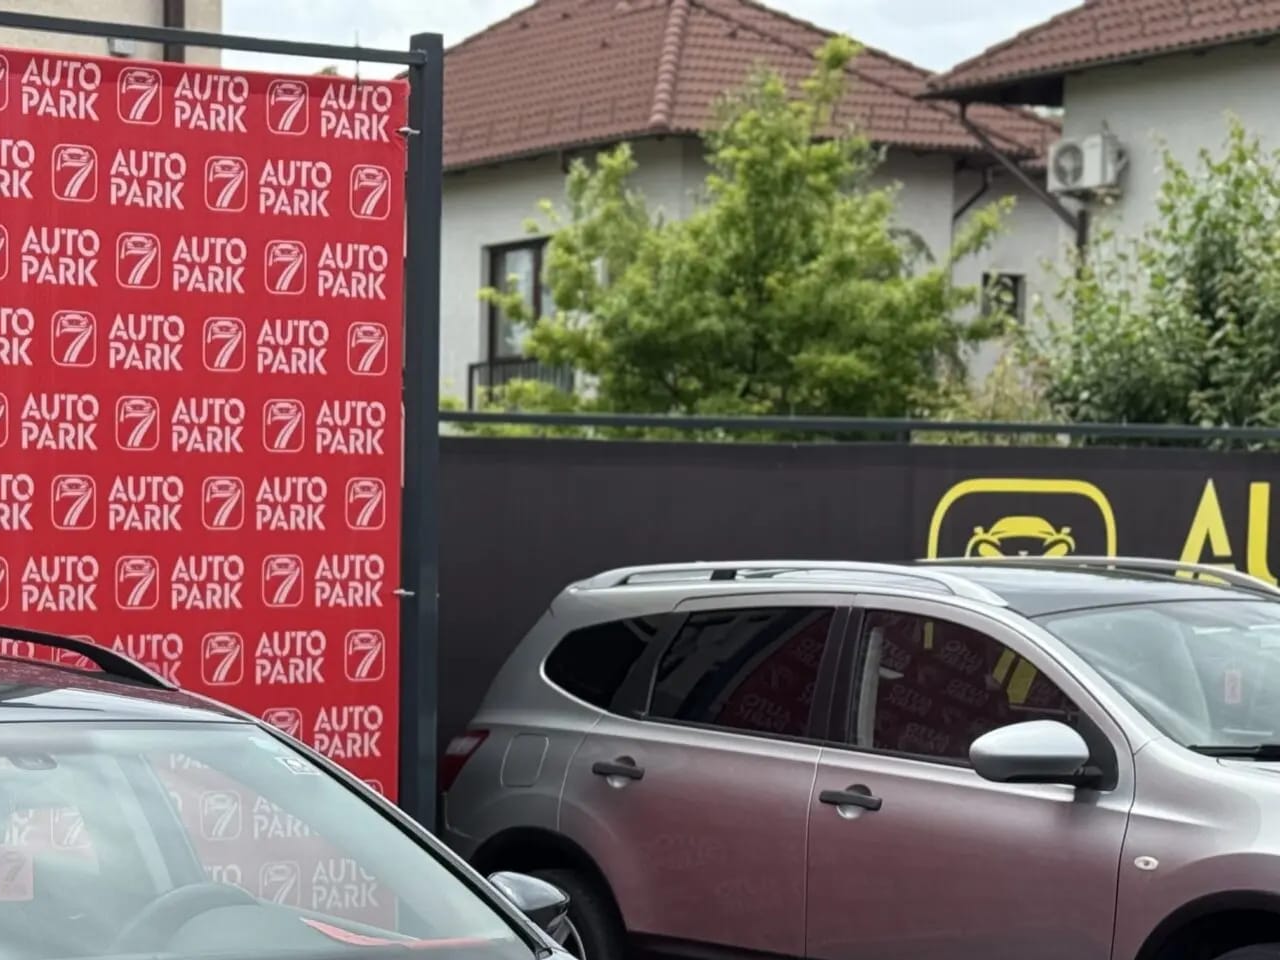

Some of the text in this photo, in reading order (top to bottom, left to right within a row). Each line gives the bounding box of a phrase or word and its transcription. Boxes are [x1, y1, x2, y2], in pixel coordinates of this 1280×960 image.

[21, 59, 101, 91] AUTO
[174, 73, 249, 104] AUTO
[22, 86, 99, 121] PARK
[320, 84, 392, 112] AUTO
[175, 100, 247, 132] PARK
[321, 110, 389, 142] PARK
[110, 149, 186, 180] AUTO
[259, 160, 331, 188] AUTO
[111, 177, 184, 209] PARK
[260, 187, 329, 217] PARK
[21, 226, 99, 257] AUTO
[173, 236, 246, 265] AUTO
[22, 255, 97, 286] PARK
[318, 243, 387, 272] AUTO
[173, 264, 244, 293] PARK
[318, 270, 385, 299] PARK
[109, 314, 184, 342] AUTO
[257, 319, 329, 347] AUTO
[110, 342, 182, 370] PARK
[258, 346, 326, 374] PARK
[21, 393, 99, 421] AUTO
[172, 398, 245, 425] AUTO
[316, 400, 385, 427] AUTO
[22, 421, 97, 450] PARK
[172, 425, 243, 452] PARK
[316, 427, 384, 454] PARK
[109, 476, 183, 502] AUTO
[256, 476, 327, 503] AUTO
[109, 502, 181, 530] PARK
[256, 504, 325, 530] PARK
[22, 556, 99, 583] AUTO
[171, 555, 244, 581] AUTO
[315, 554, 384, 580] AUTO
[22, 584, 96, 611] PARK
[172, 582, 242, 610] PARK
[315, 581, 382, 607] PARK
[255, 630, 326, 657] AUTO
[256, 655, 324, 684] PARK
[314, 705, 383, 731] AUTO
[314, 732, 381, 757] PARK
[312, 884, 379, 909] PARK
